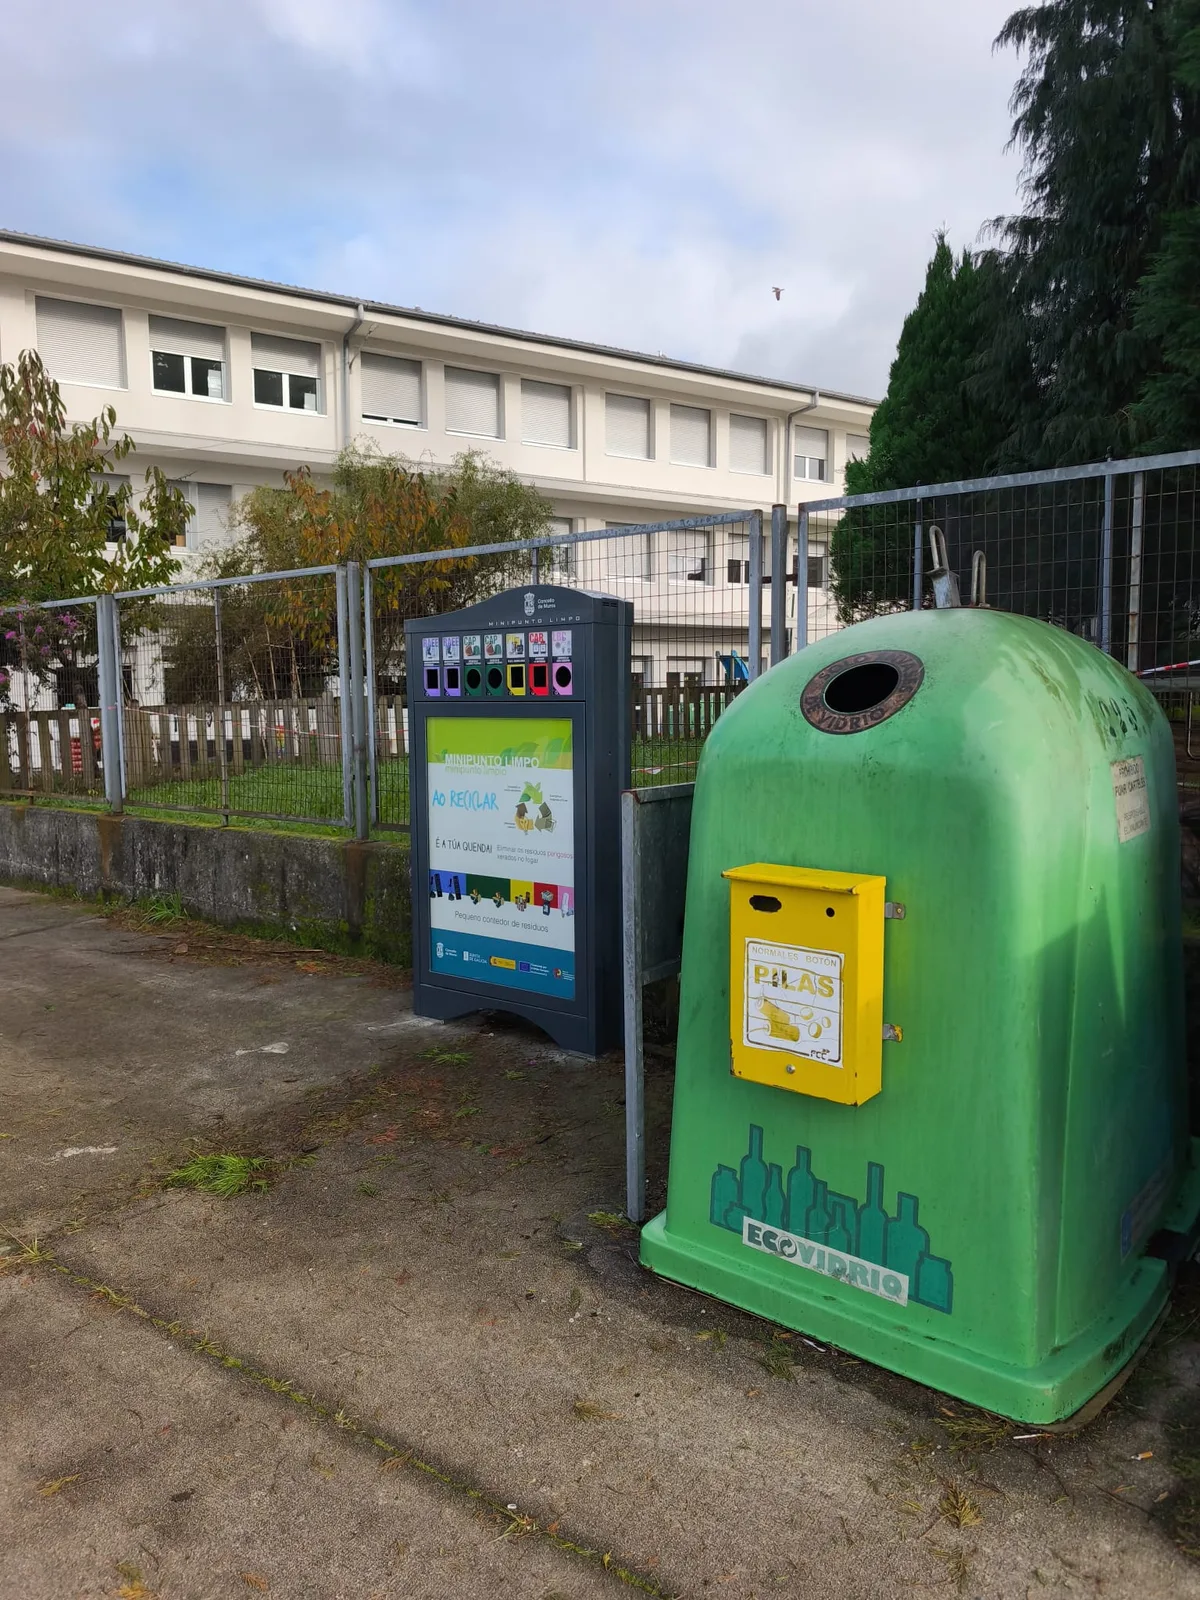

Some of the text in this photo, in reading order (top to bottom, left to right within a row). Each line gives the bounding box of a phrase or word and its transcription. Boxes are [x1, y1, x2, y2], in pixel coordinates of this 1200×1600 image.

[488, 615, 581, 627] MINIPUNTO LIMPO
[423, 638, 439, 647] RAEE
[443, 637, 459, 647] RAEE
[463, 636, 477, 646] CAP
[484, 635, 498, 645] CAP
[817, 707, 886, 731] VIDRIO
[445, 753, 540, 768] MINIPUNTO LIMPO
[445, 766, 507, 776] minipunto limpio
[432, 789, 499, 811] AO RECICLAR
[441, 839, 447, 849] A
[447, 838, 461, 850] TÚA
[454, 910, 482, 922] Pequeno
[482, 915, 510, 926] contedor
[511, 919, 520, 928] de
[752, 946, 837, 967] NORMALES BOTÓN
[754, 964, 835, 998] PILAS
[810, 1050, 827, 1060] FCC
[747, 1223, 903, 1298] ECOVIDRIO
